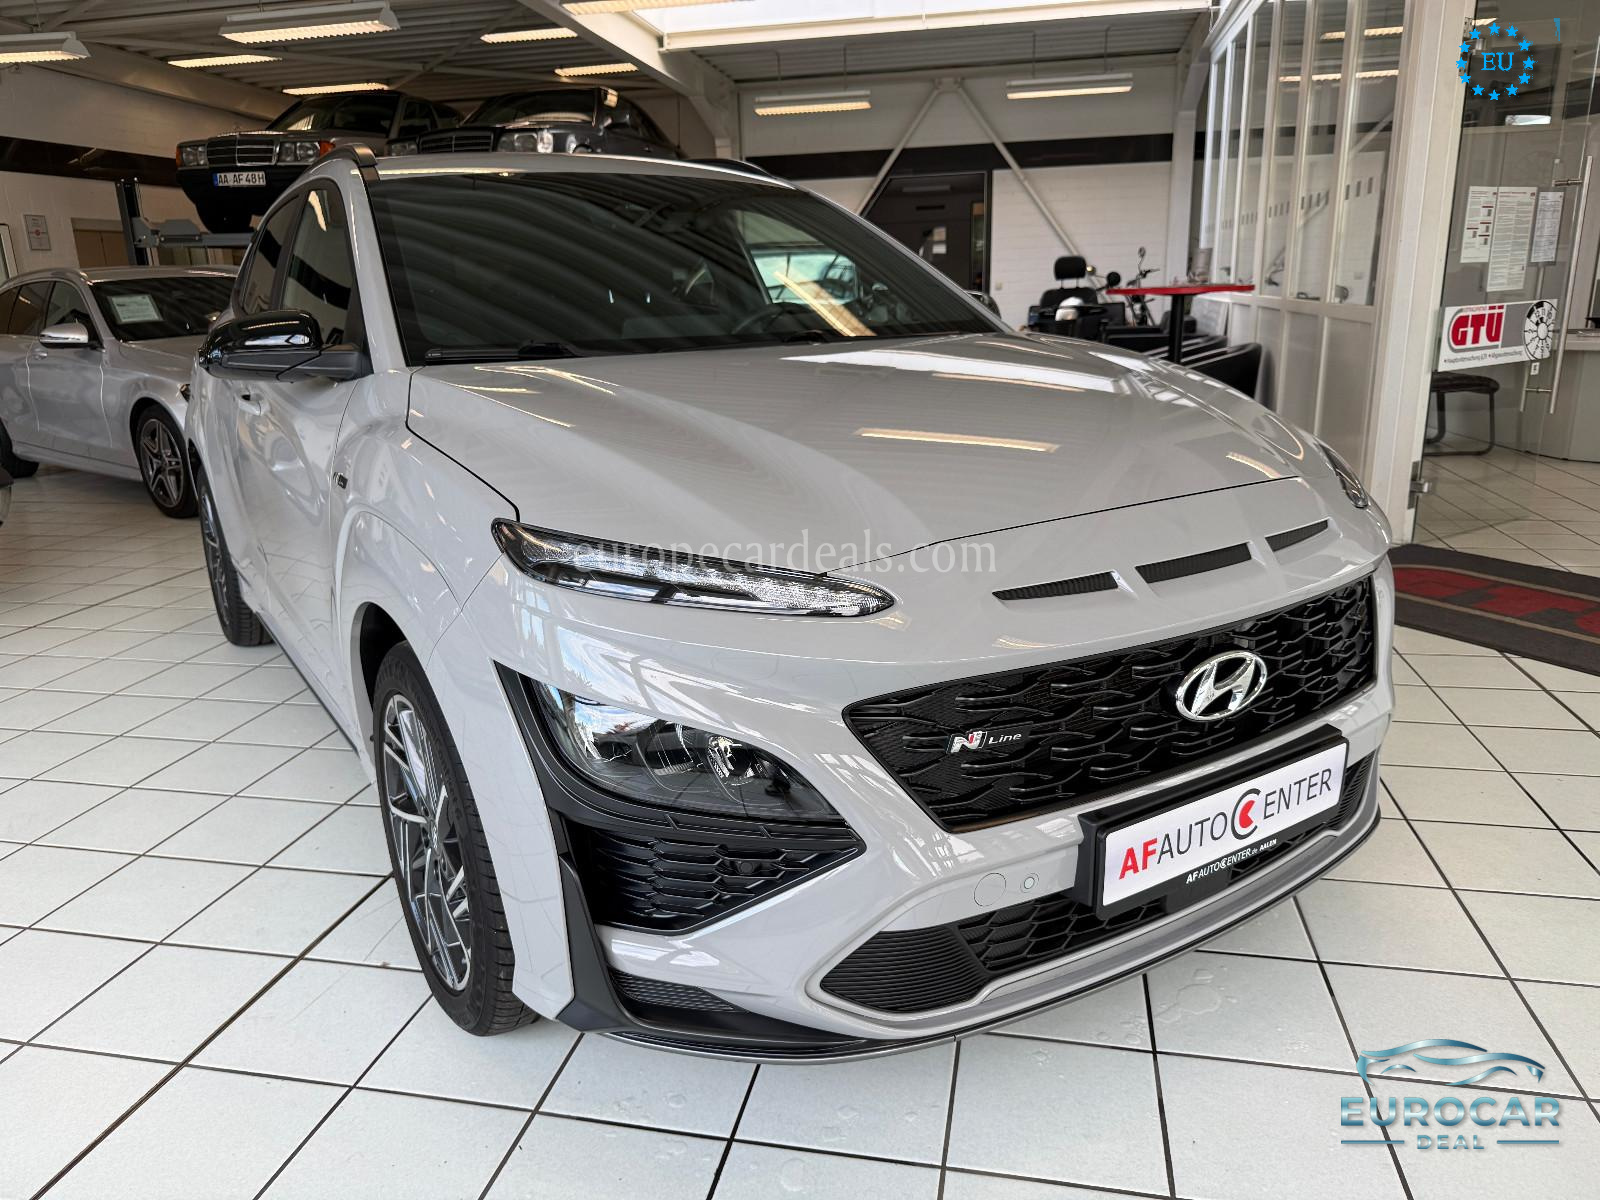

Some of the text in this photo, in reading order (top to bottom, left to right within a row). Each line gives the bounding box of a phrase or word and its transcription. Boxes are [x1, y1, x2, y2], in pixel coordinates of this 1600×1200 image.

[218, 174, 229, 184] AA
[233, 174, 244, 184] AF
[1451, 304, 1505, 346] GTÜ
[988, 733, 1022, 744] Line
